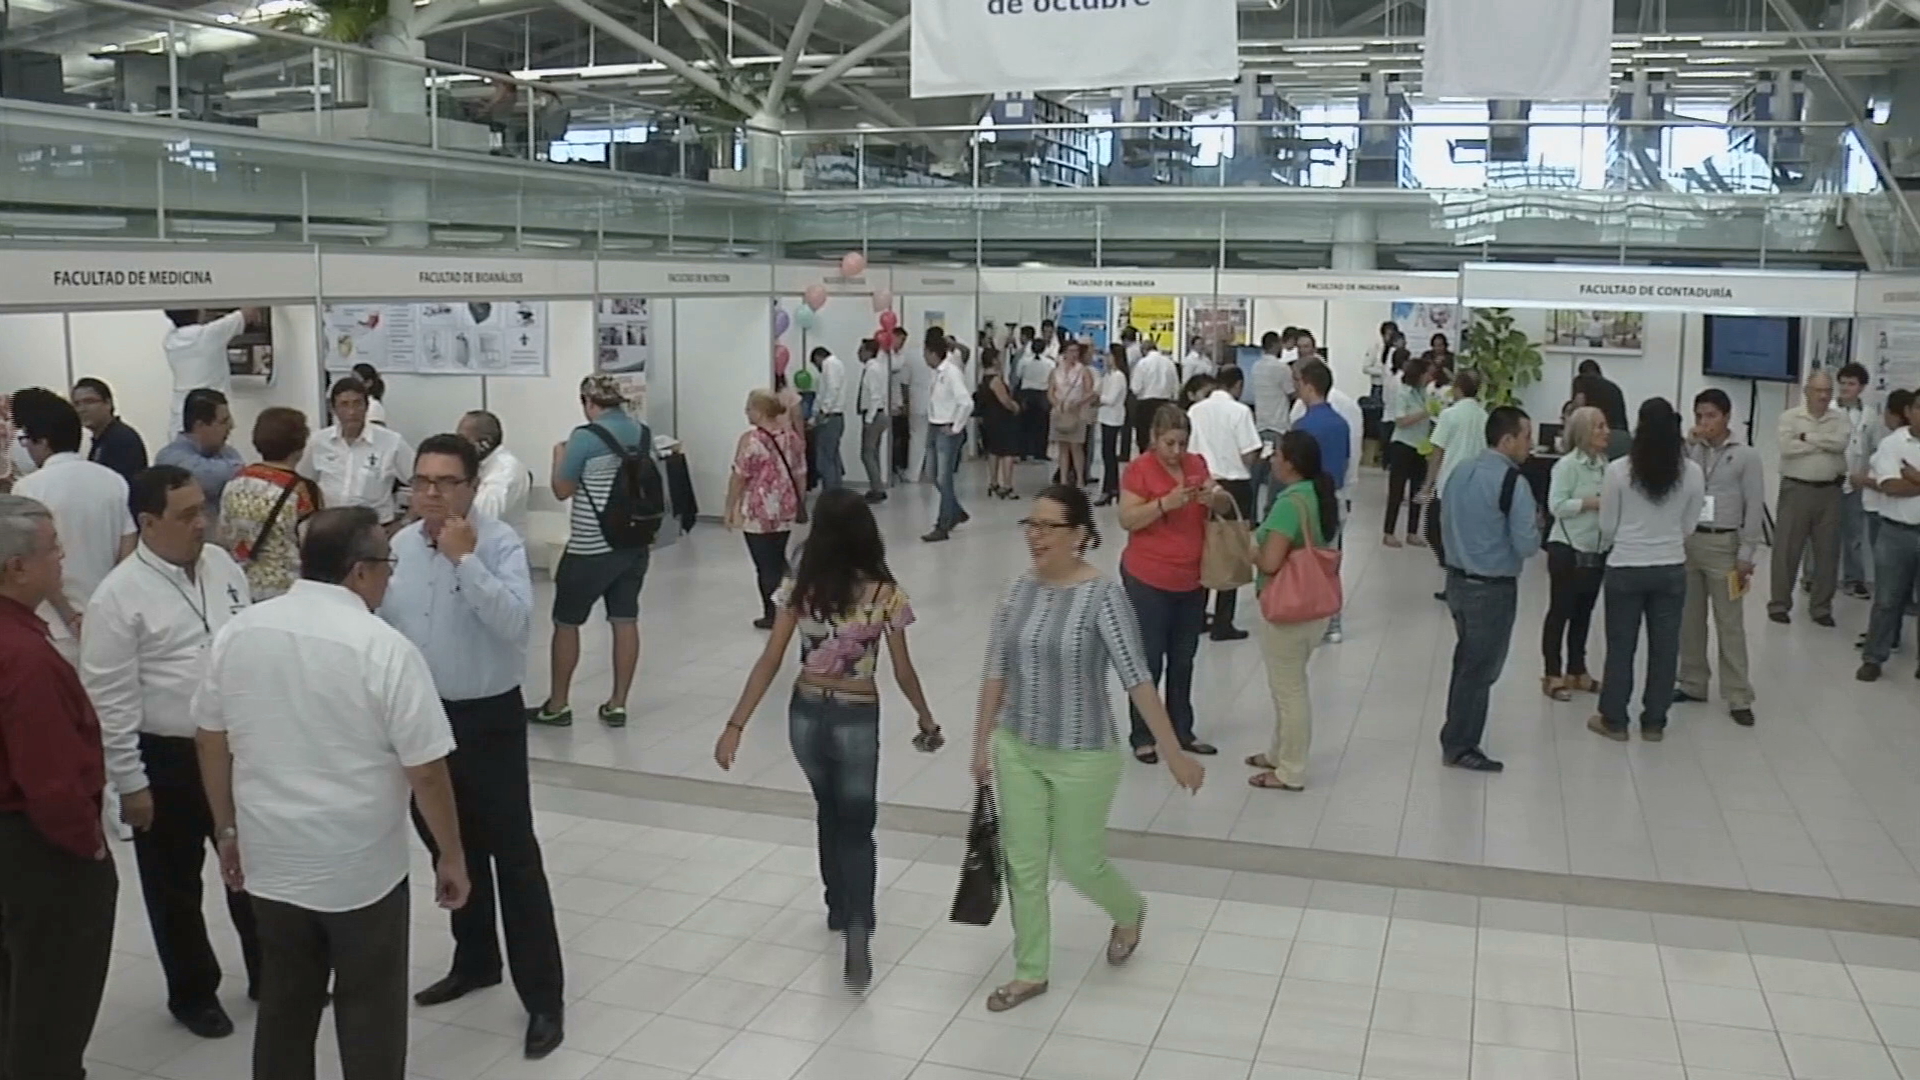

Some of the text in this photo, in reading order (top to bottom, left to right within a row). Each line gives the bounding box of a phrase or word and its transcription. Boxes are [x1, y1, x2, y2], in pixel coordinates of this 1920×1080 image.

[987, 0, 1023, 15] de
[53, 270, 213, 286] FACULTAD DE MEDICINA
[419, 271, 461, 283] FACULTAD
[463, 271, 474, 283] DE
[1067, 279, 1103, 287] FACULTAD
[1306, 282, 1344, 291] FACULTAD
[1345, 283, 1356, 291] DE
[1579, 284, 1733, 299] FACULTAD DE CONTADURÍA
